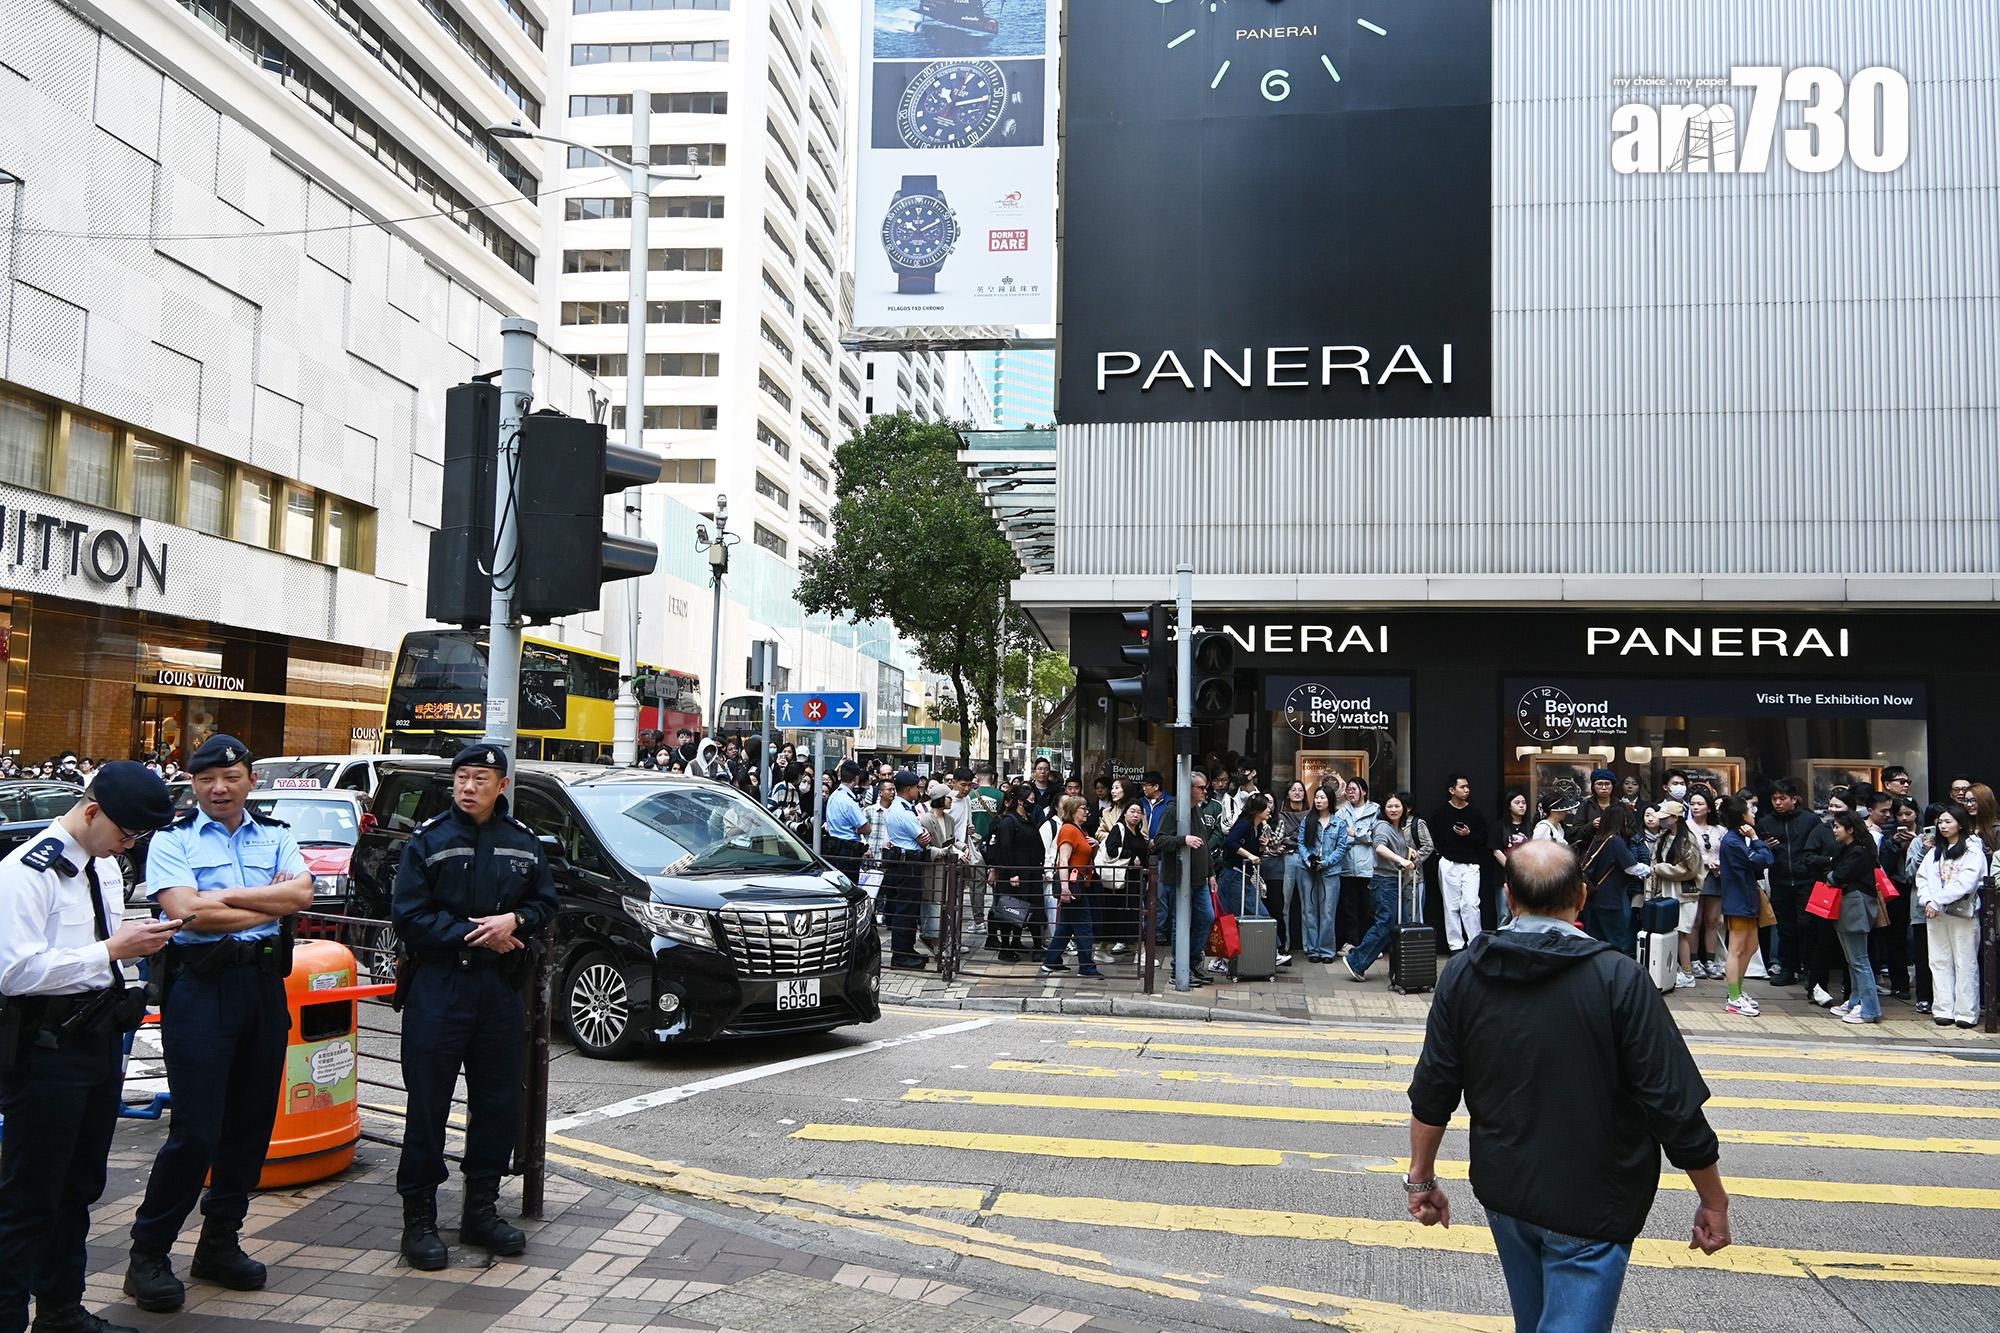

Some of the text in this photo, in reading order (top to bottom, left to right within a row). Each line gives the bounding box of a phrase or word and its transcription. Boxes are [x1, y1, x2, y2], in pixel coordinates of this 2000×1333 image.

[1236, 25, 1317, 40] PANERAI
[1260, 69, 1291, 102] 6
[991, 231, 1013, 239] BORN
[991, 239, 1025, 250] DARE
[1096, 343, 1453, 392] PANERAI
[1586, 627, 1849, 658] PANERAI
[158, 670, 245, 691] LOUIS VUITTON
[1311, 696, 1371, 712] Beyond
[1756, 693, 1913, 706] Visit The Exhibition Now
[454, 703, 482, 720] A25
[1520, 709, 1527, 717] 9
[1545, 699, 1608, 716] Beyond
[395, 719, 411, 727] 8032
[1310, 710, 1389, 724] the watch
[1545, 714, 1627, 728] the watch
[352, 727, 376, 740] LOUIS
[1543, 731, 1550, 739] 6
[1112, 765, 1145, 775] Beyond
[278, 779, 317, 788] TAXI
[510, 859, 529, 868] POLICE
[789, 980, 808, 995] KW
[779, 993, 818, 1010] 6030
